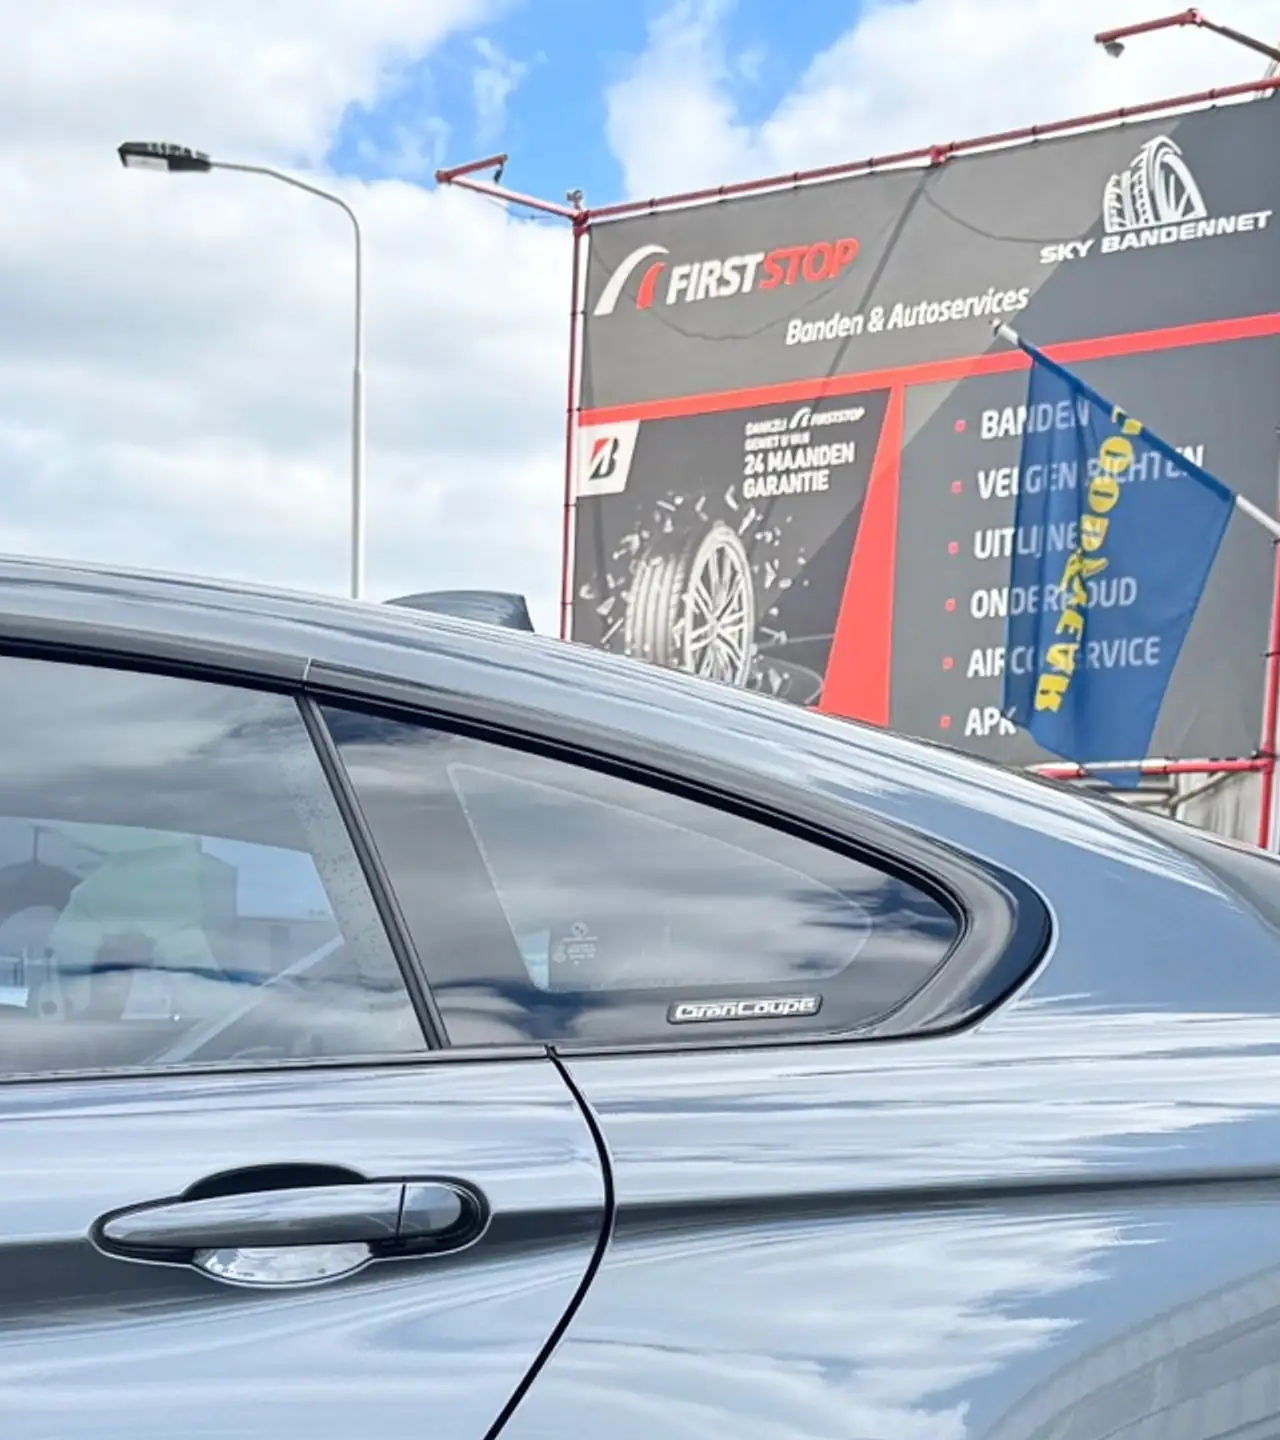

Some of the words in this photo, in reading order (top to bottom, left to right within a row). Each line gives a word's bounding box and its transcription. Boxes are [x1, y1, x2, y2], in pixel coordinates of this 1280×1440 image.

[1039, 239, 1095, 264] SKY
[1101, 210, 1273, 254] BANDENNET
[666, 237, 860, 306] FIRSTSTOP
[786, 309, 865, 346] Banden
[867, 308, 885, 333] &
[887, 286, 1031, 331] Autoservices
[980, 399, 1090, 440] BANDEN
[743, 452, 765, 476] 24
[767, 440, 856, 473] MAANDEN
[742, 468, 831, 500] GARANTIE
[964, 705, 1017, 737] APK
